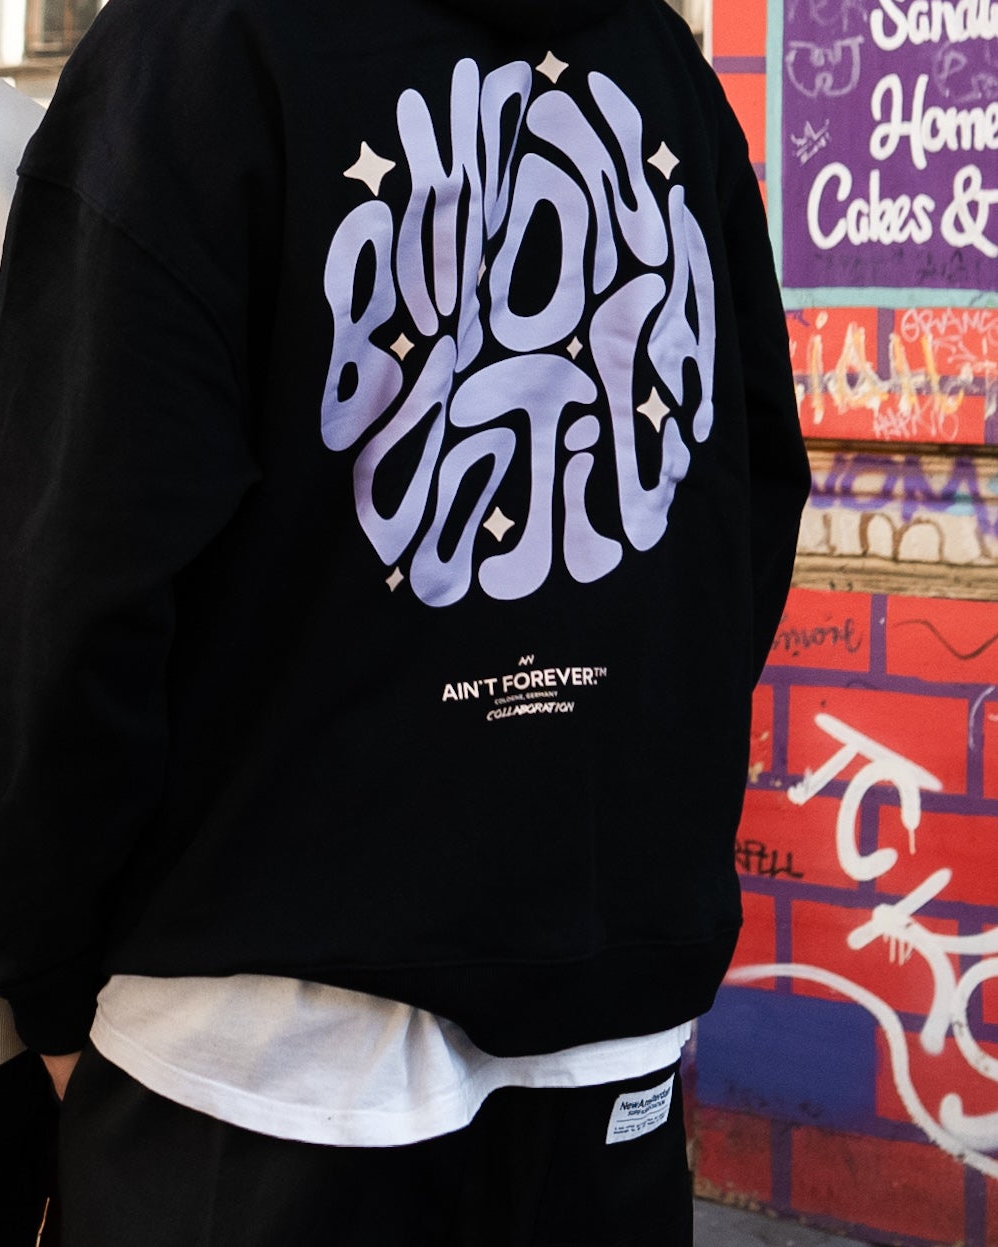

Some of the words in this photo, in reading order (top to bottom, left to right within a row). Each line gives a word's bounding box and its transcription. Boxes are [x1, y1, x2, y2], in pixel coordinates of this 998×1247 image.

[806, 161, 935, 250] Cakes
[442, 677, 498, 702] AIN'T
[486, 701, 575, 722] COLLABORATION
